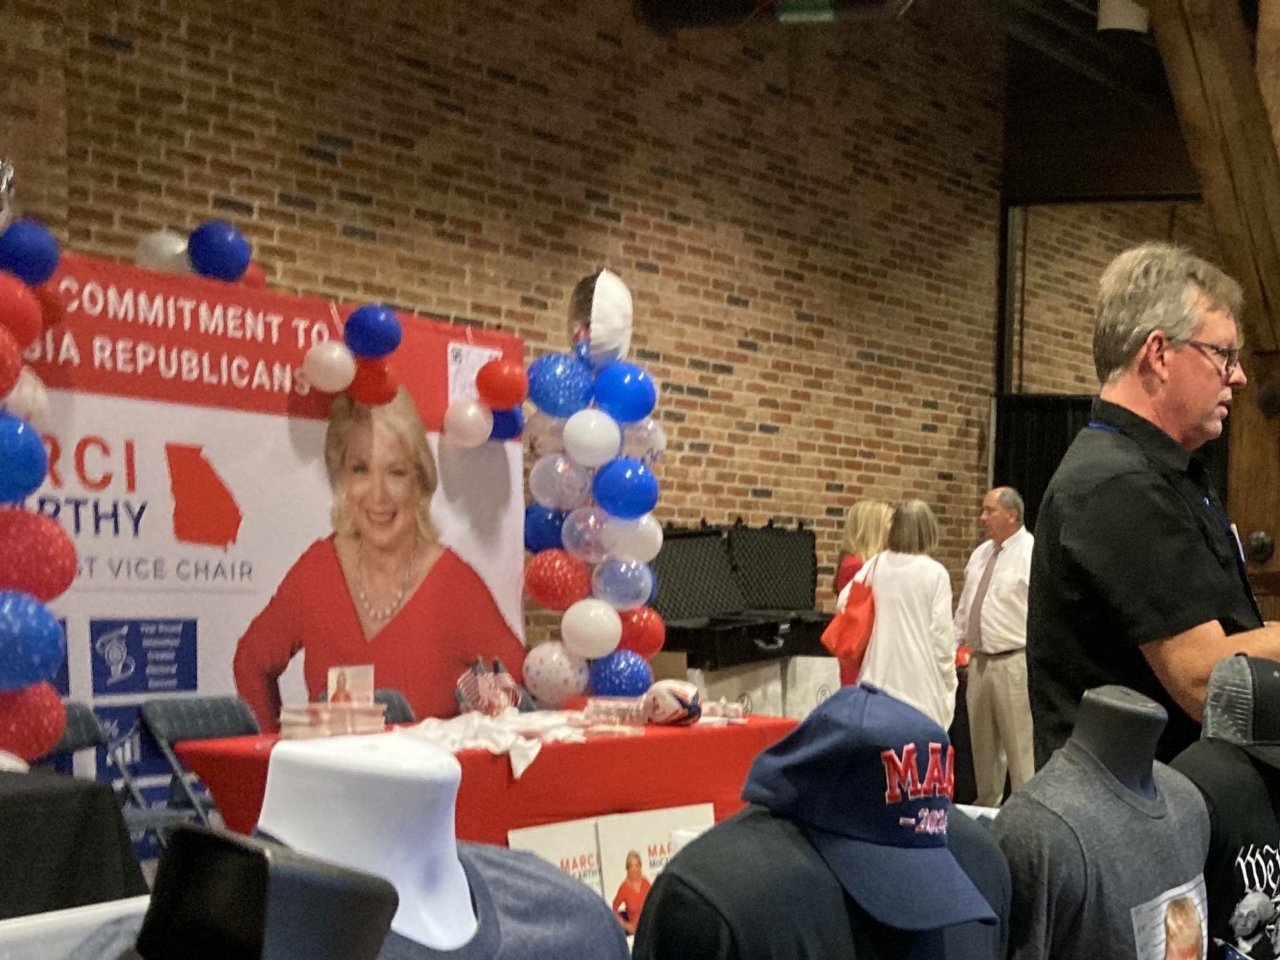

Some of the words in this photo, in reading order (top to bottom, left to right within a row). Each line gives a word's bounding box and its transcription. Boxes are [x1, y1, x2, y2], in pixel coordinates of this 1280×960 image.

[58, 275, 284, 346] COMMITMENT
[92, 336, 311, 396] REPUBLICANS
[108, 555, 166, 580] VICE
[175, 558, 254, 582] CHAIR
